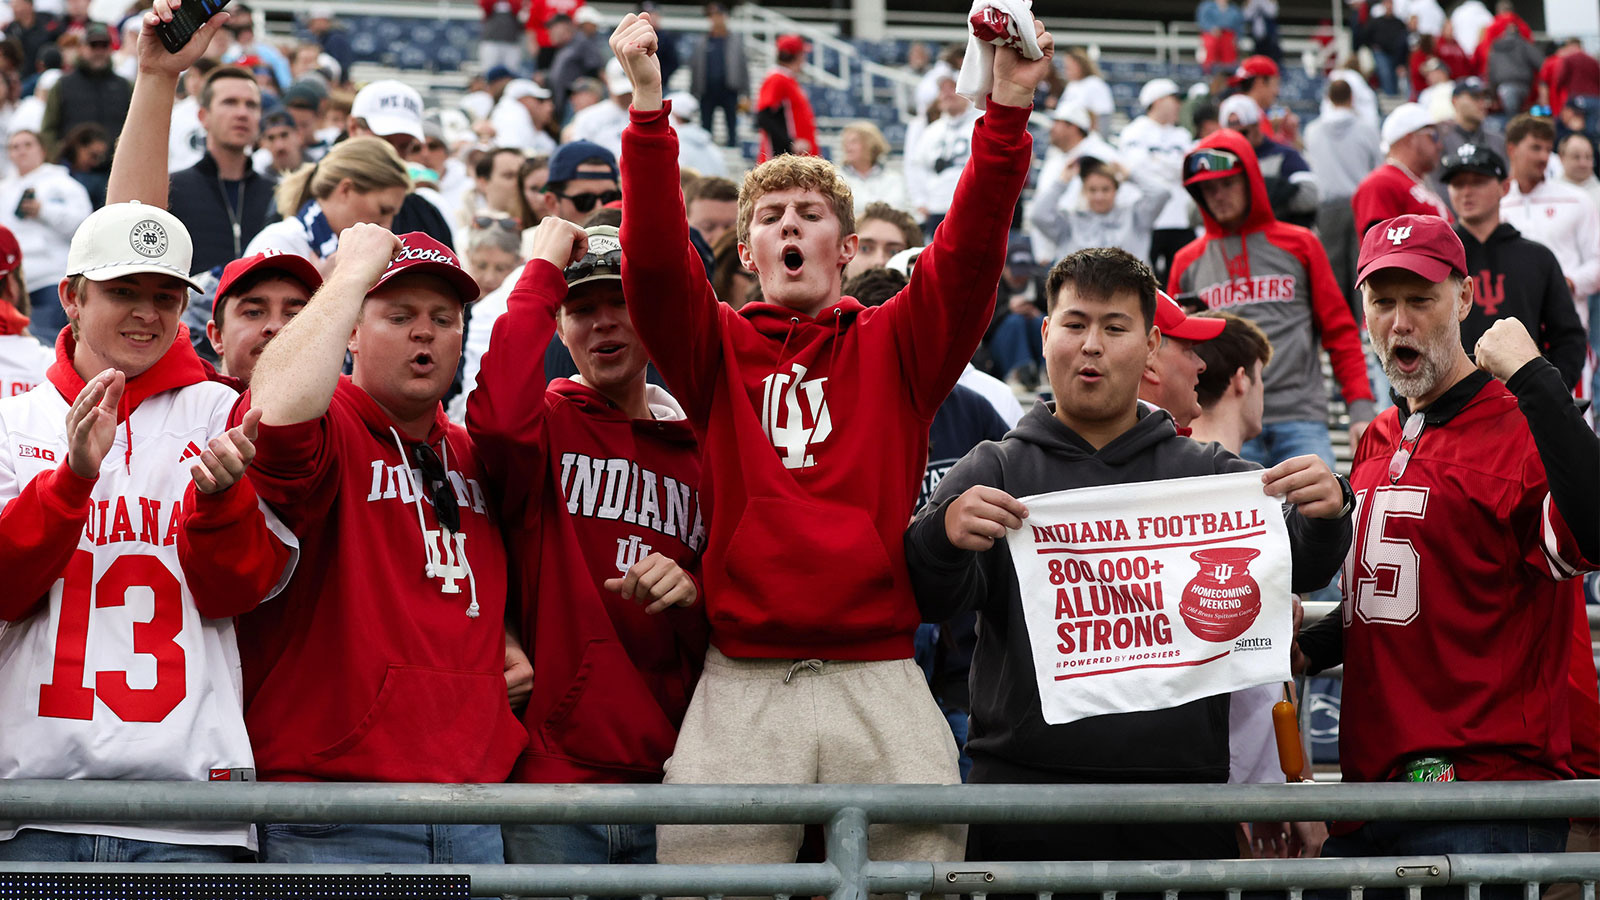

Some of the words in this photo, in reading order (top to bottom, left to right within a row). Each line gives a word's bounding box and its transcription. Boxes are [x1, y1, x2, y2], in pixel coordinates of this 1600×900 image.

[134, 223, 151, 236] NOTRE
[600, 238, 621, 250] DEER
[1031, 519, 1131, 543] INDIANA
[1137, 508, 1265, 540] FOOTBALL
[1048, 556, 1165, 586] 800,000+
[1054, 581, 1164, 620] ALUMNI
[1190, 584, 1252, 598] HOMECOMING
[1187, 606, 1198, 614] Old
[1199, 597, 1242, 610] WEEKEND
[38, 549, 187, 722] 13
[1056, 612, 1173, 655] STRONG
[1056, 656, 1112, 669] #POWERED
[1114, 654, 1127, 663] BY
[1128, 649, 1181, 661] HOOSIERS
